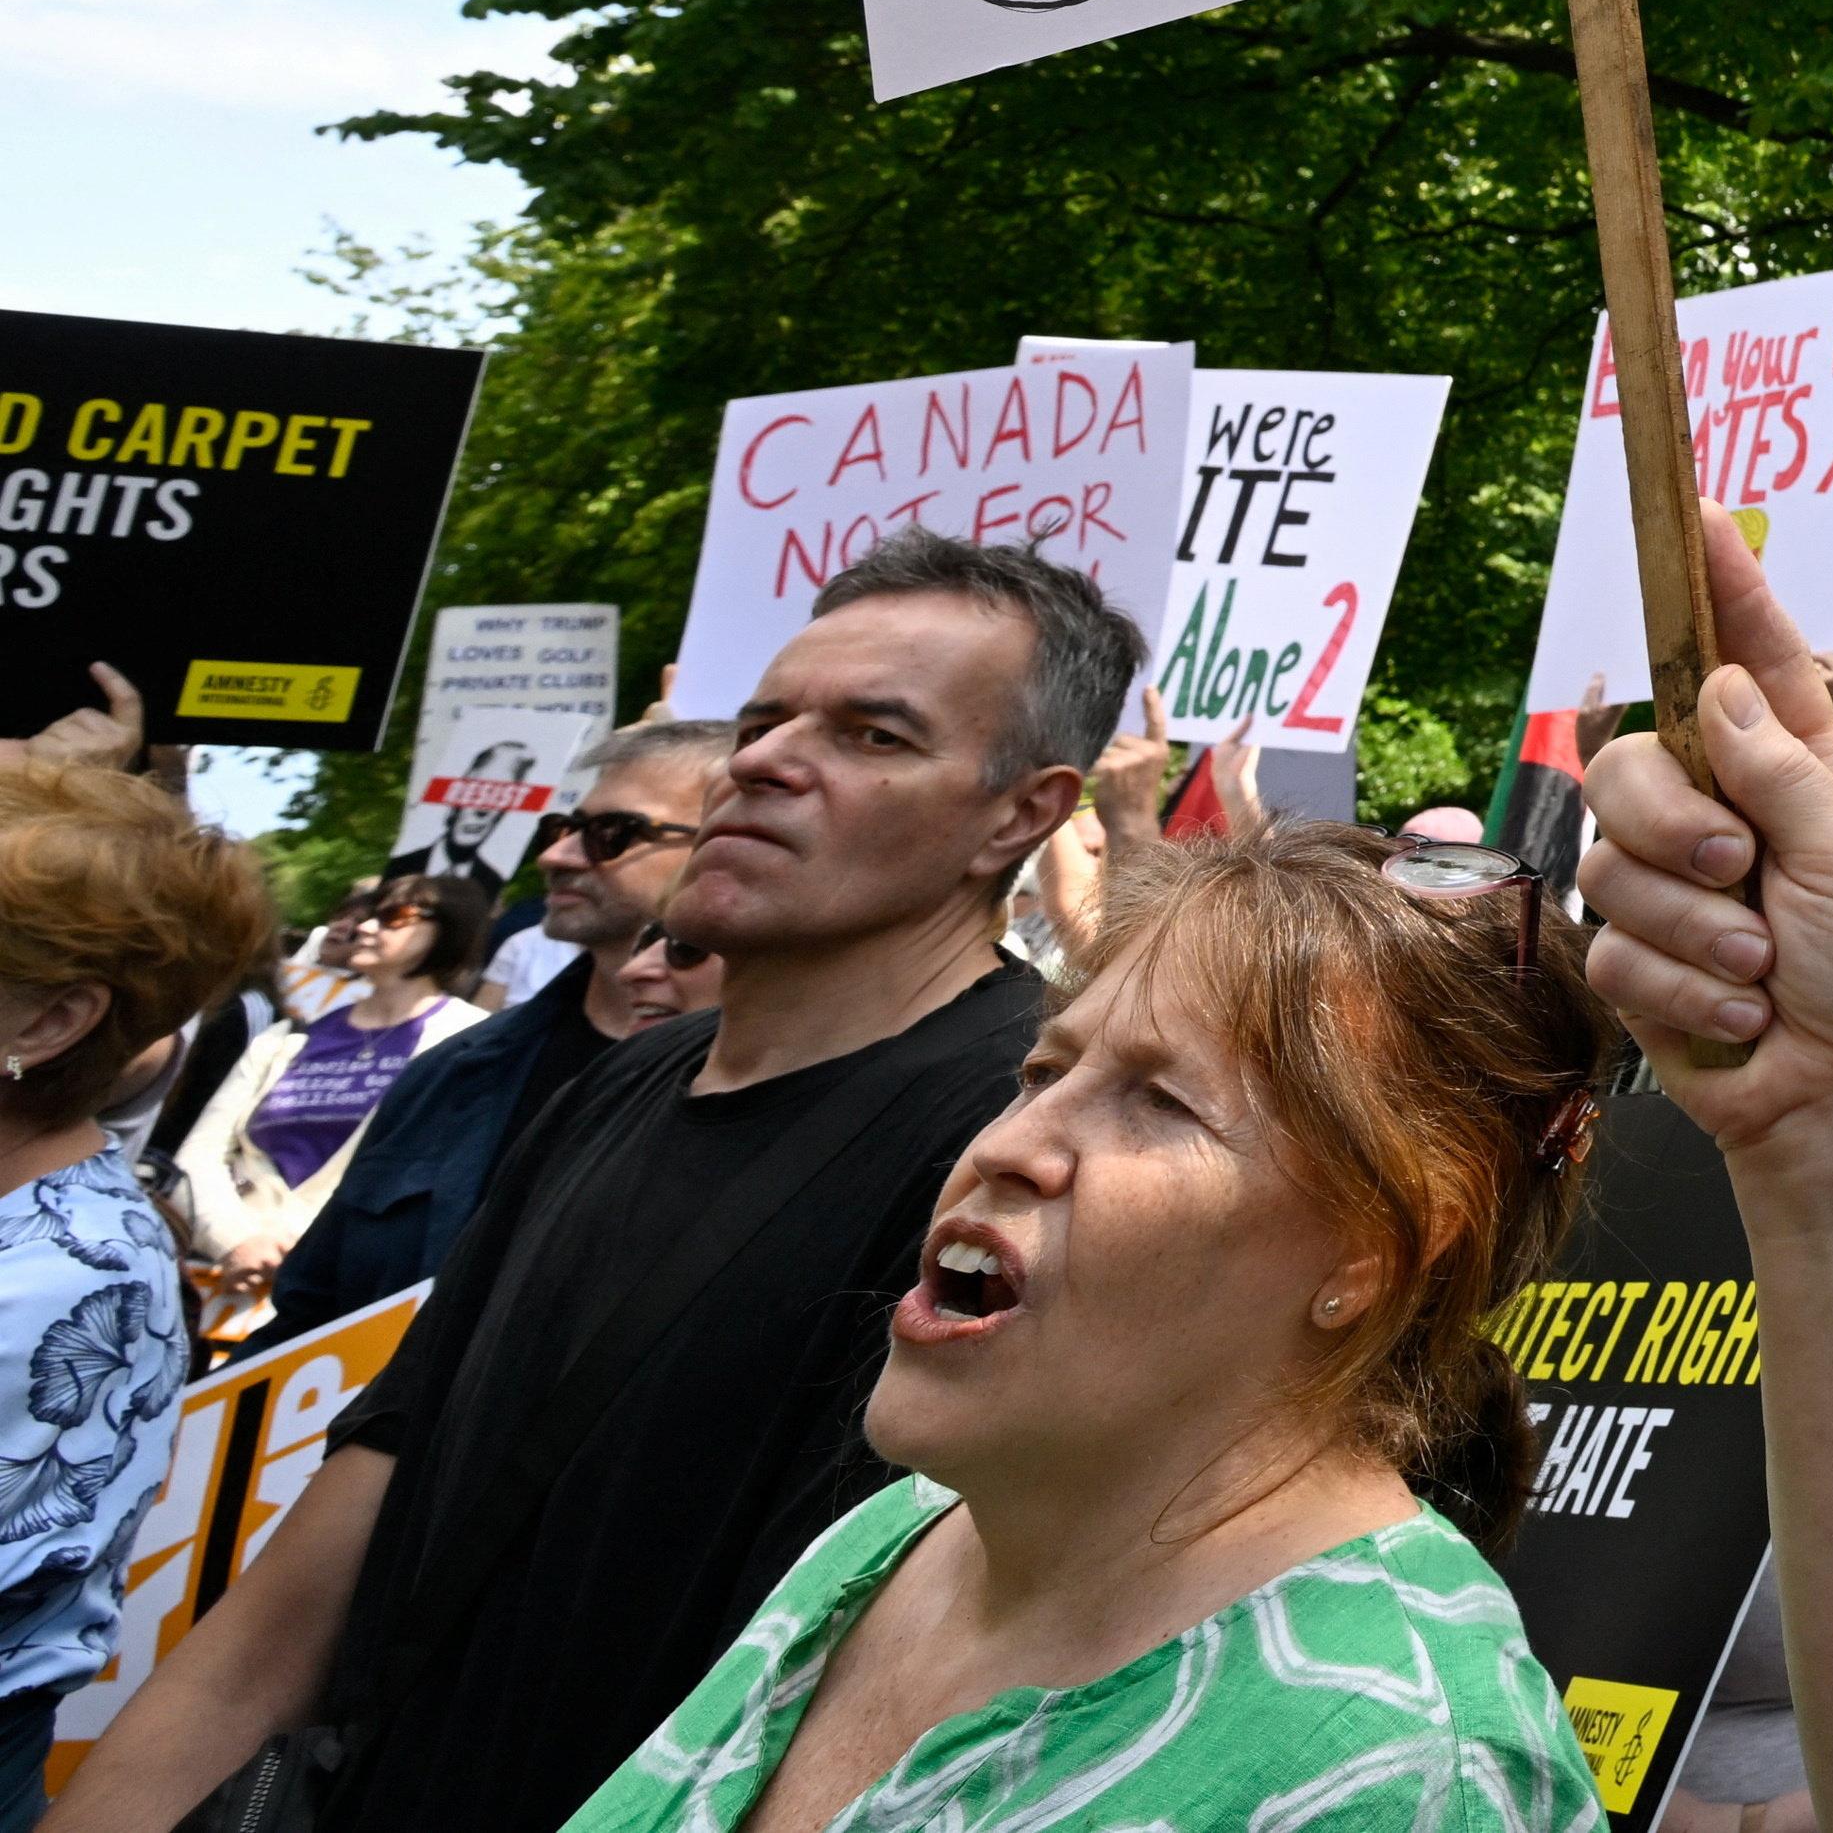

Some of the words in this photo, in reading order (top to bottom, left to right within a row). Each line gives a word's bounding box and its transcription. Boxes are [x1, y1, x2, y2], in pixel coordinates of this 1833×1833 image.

[1722, 326, 1821, 403] your
[66, 397, 373, 479] CARPET
[739, 360, 1146, 511] CANADA
[1206, 402, 1337, 470] were
[1690, 383, 1813, 505] ATES
[973, 482, 1128, 552] FOR
[201, 674, 295, 693] AMNESTY
[1157, 577, 1303, 721] Alone
[1283, 579, 1359, 734] 2
[1482, 1279, 1650, 1382] OTECT
[1525, 1404, 1675, 1519] HATE
